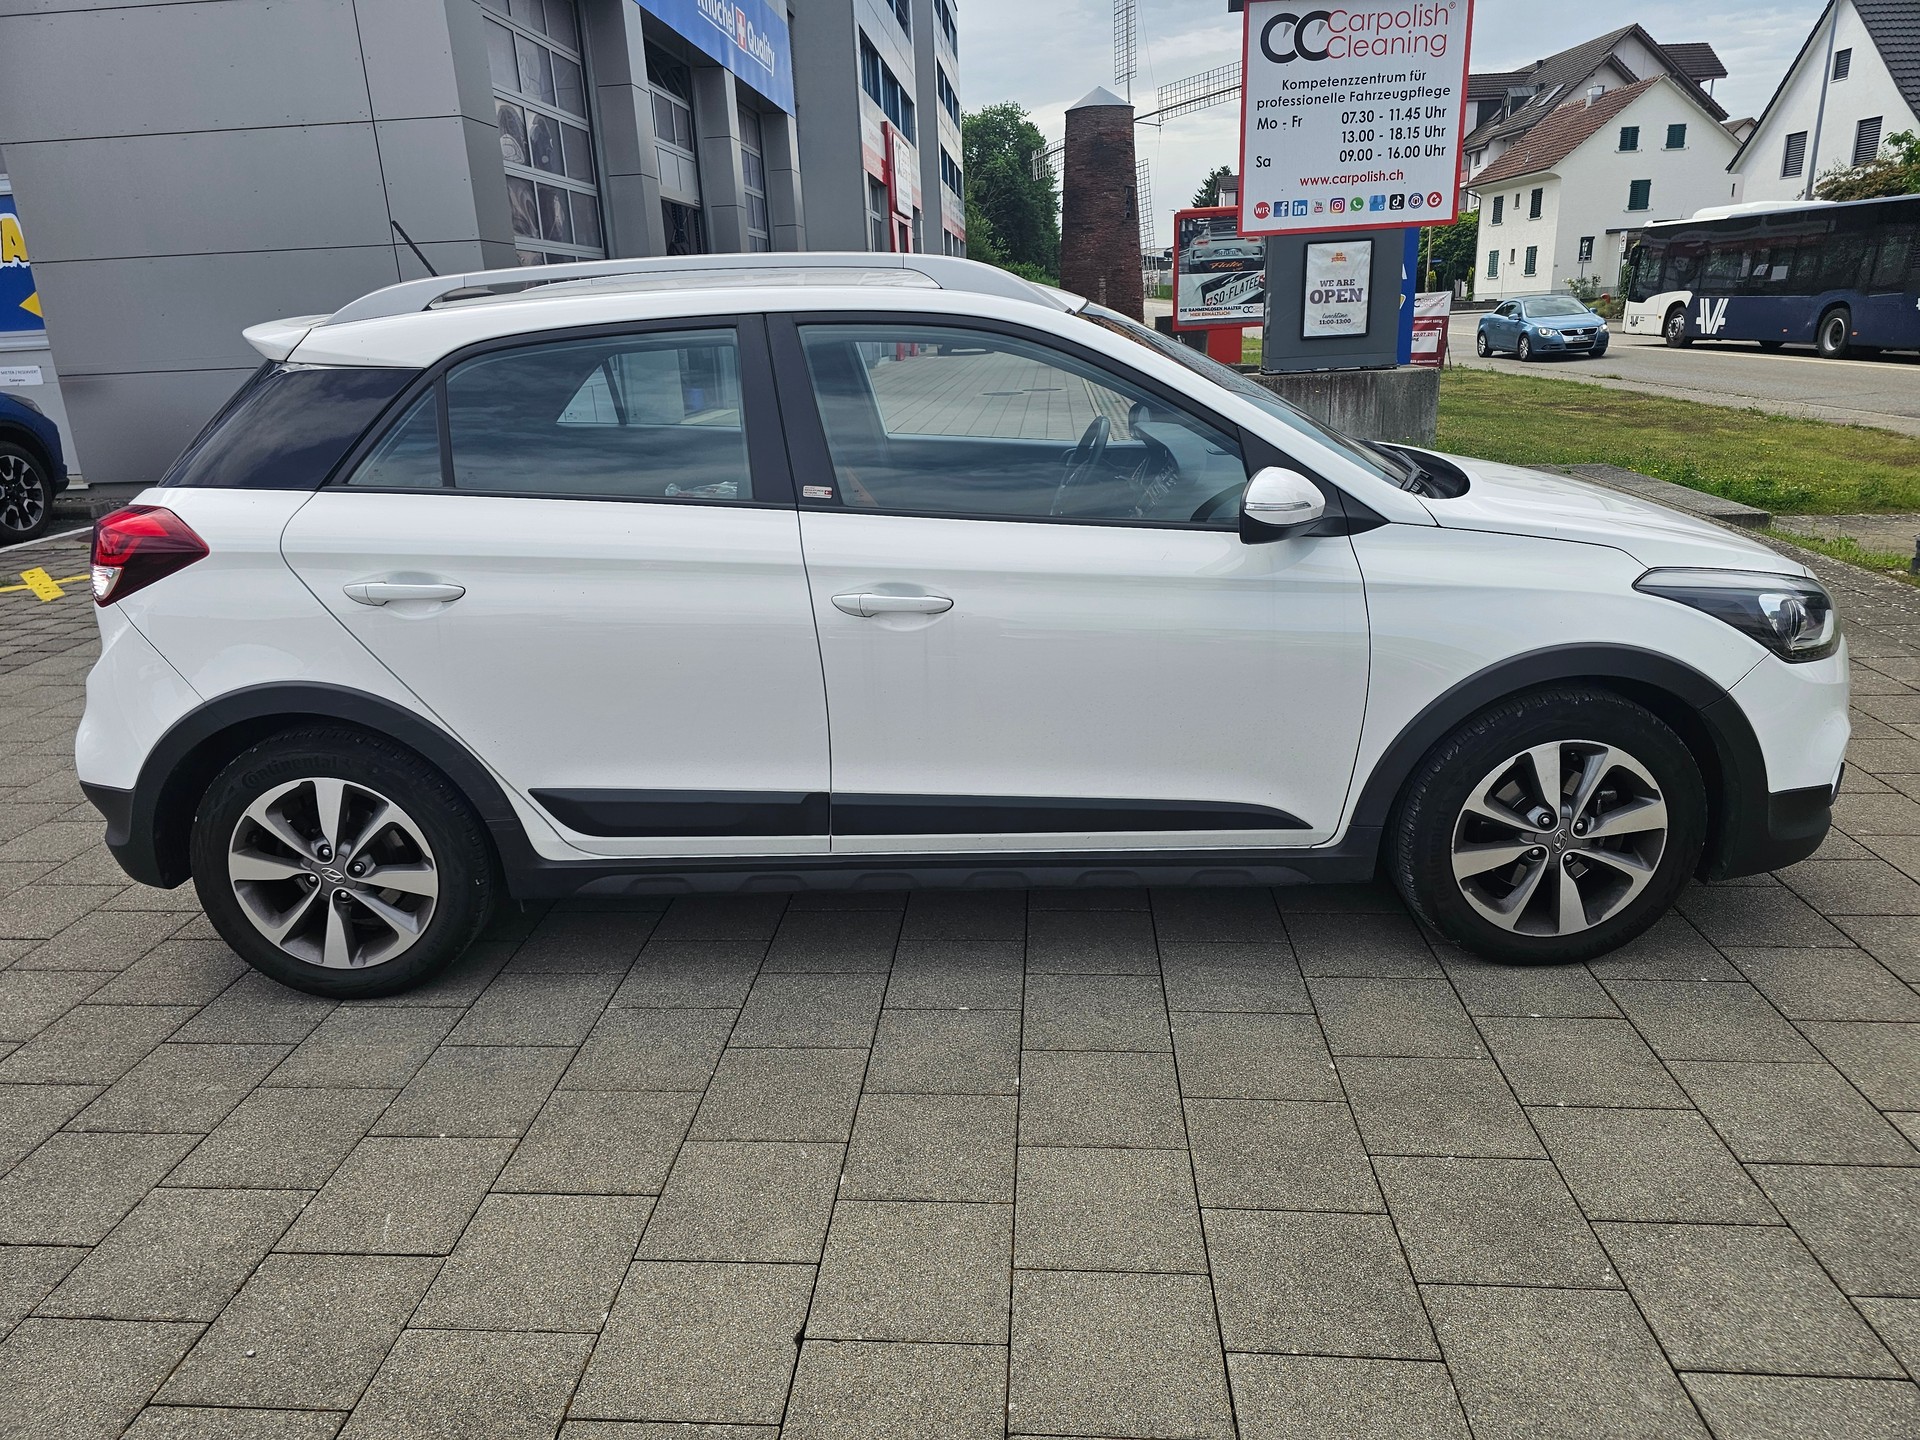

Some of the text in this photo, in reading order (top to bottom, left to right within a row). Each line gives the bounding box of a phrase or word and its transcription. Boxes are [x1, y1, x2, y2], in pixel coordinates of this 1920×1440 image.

[1327, 3, 1449, 36] Carpolish
[698, 0, 775, 77] nuchel Quality
[1326, 31, 1448, 59] Cleaning
[1282, 70, 1427, 91] Kompetenzzentrum für
[1257, 86, 1451, 111] professionelle Fahrzeugpflege
[1257, 117, 1278, 130] Mo
[1292, 116, 1303, 128] Fr
[1341, 110, 1375, 125] 07.30
[1389, 107, 1421, 122] 11.45
[1425, 106, 1447, 119] Uhr
[1341, 129, 1375, 144] 13.00
[1389, 126, 1420, 141] 18.15
[1424, 125, 1447, 138] Uhr
[1256, 155, 1272, 168] Sa
[1339, 148, 1373, 163] 09.00
[1387, 145, 1421, 160] 16.00
[1424, 144, 1446, 158] Uhr
[1299, 169, 1404, 187] www.carpolish.ch
[1336, 279, 1356, 287] ARE
[1309, 288, 1364, 304] OPEN
[241, 755, 339, 790] Continental
